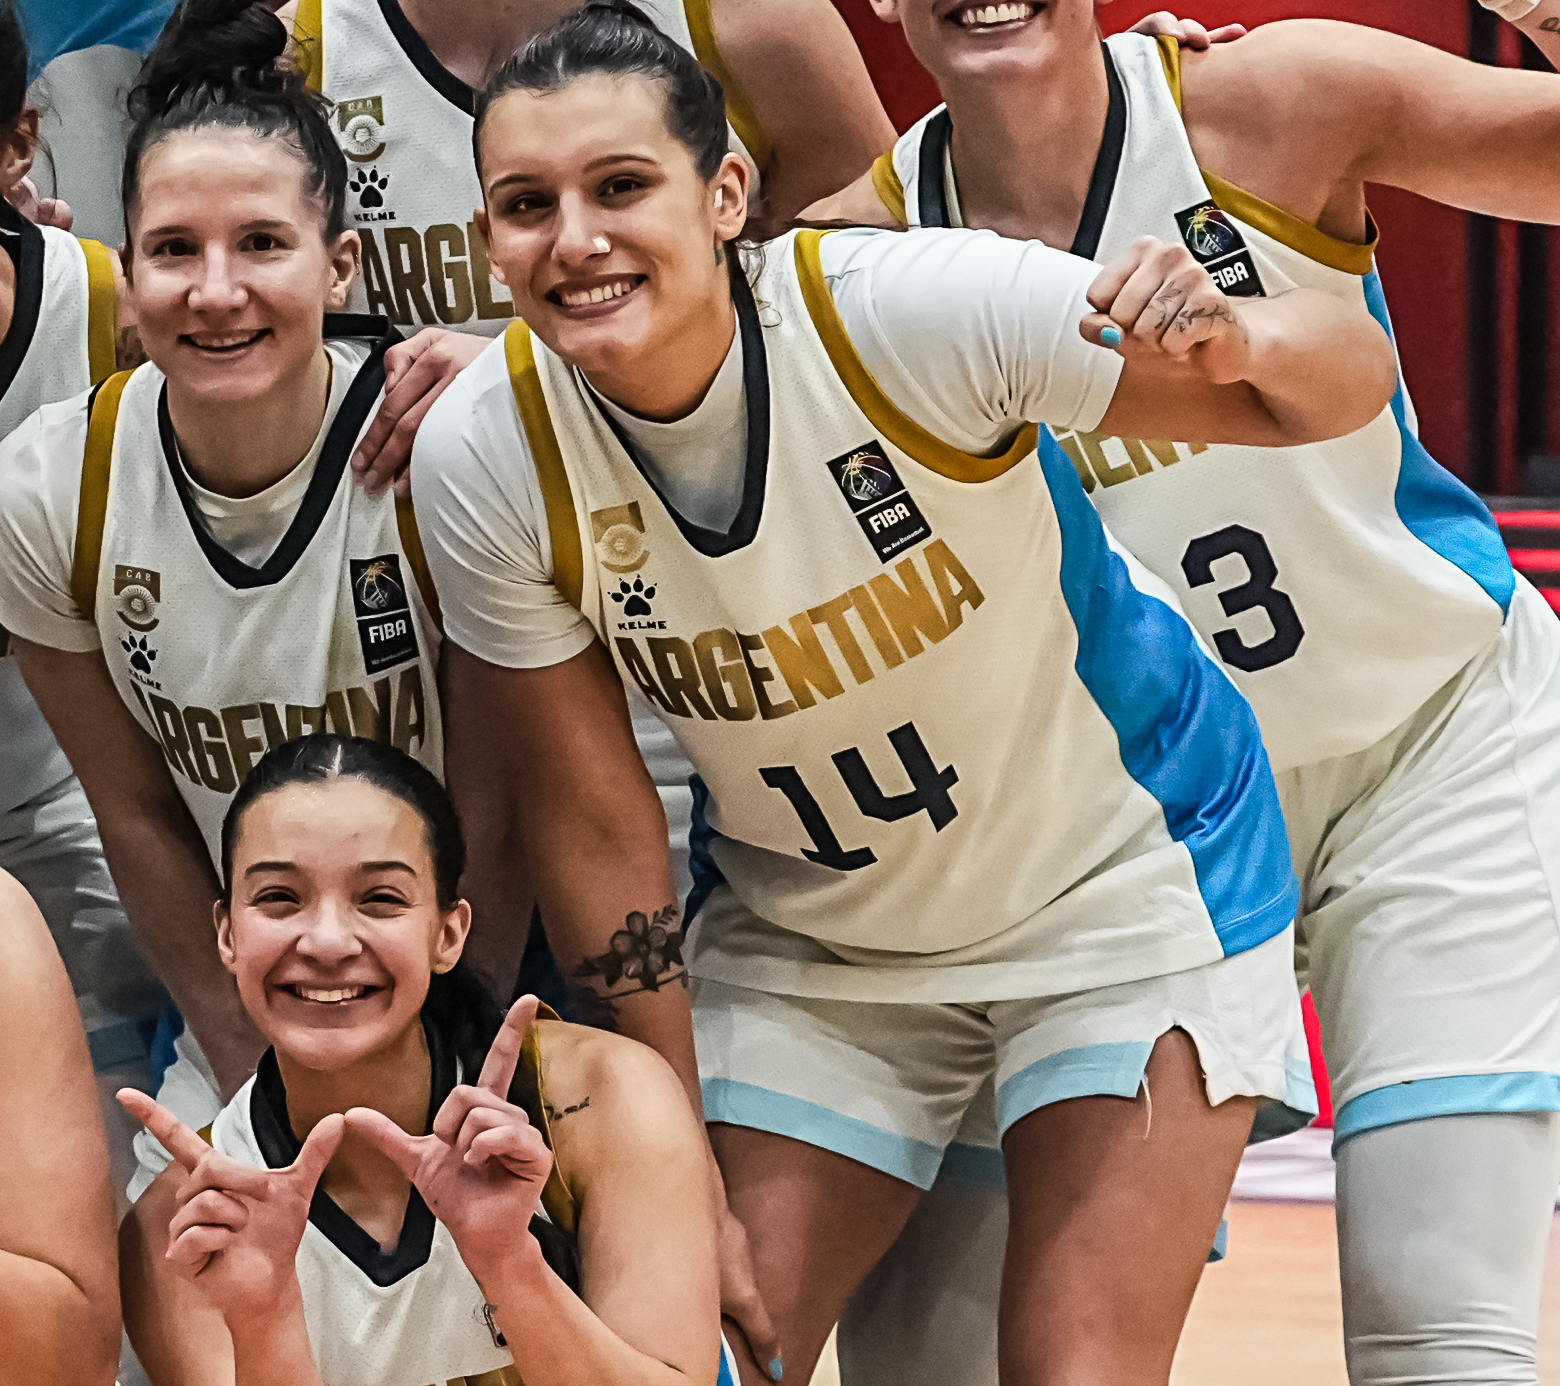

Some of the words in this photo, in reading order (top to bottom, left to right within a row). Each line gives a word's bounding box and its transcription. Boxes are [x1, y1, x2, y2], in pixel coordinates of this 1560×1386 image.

[353, 211, 397, 222] KELME
[868, 502, 911, 534] FIBA
[1180, 523, 1305, 673] 3
[368, 619, 407, 644] FIBA
[614, 538, 986, 723] ARGENTINA
[616, 619, 668, 631] KELME
[758, 720, 960, 873] 14
